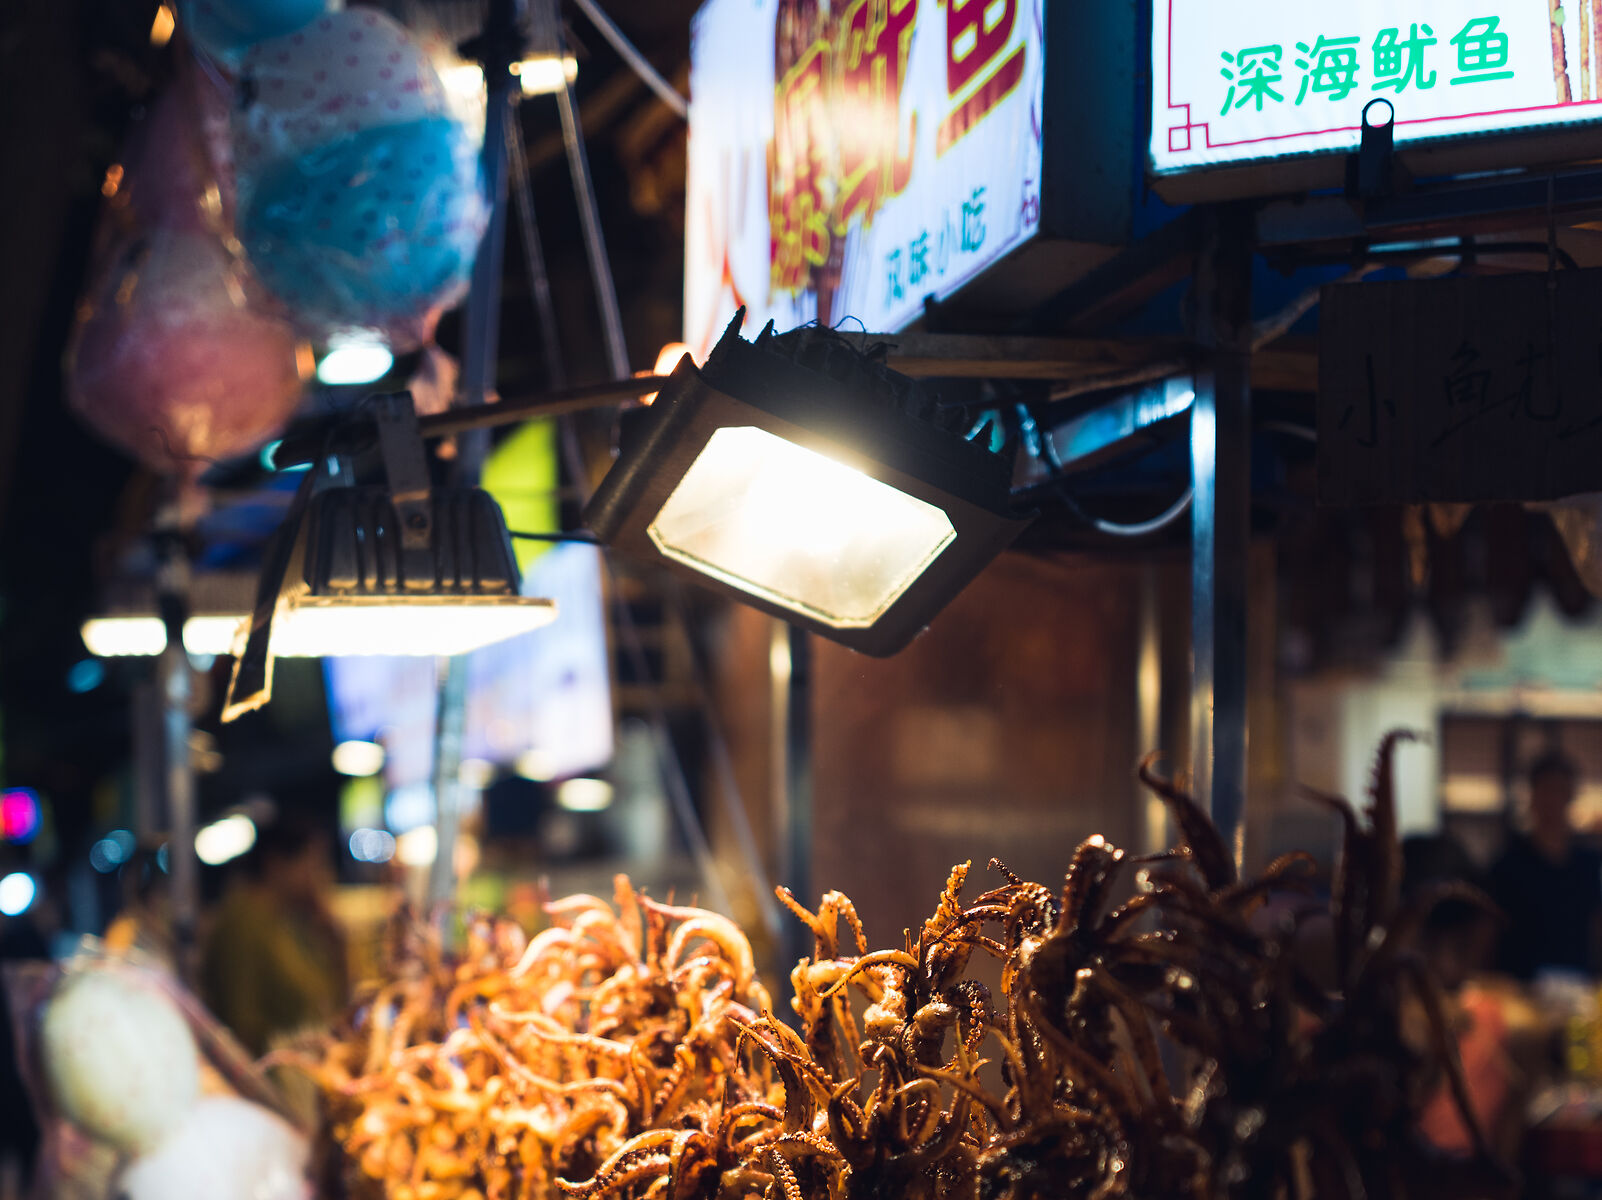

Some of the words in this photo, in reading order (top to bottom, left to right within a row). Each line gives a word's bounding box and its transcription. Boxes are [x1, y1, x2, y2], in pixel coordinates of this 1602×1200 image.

[1220, 16, 1514, 116] 深海鱿鱼
[885, 186, 987, 308] 风味小吃
[1338, 341, 1602, 447] 小鱿
